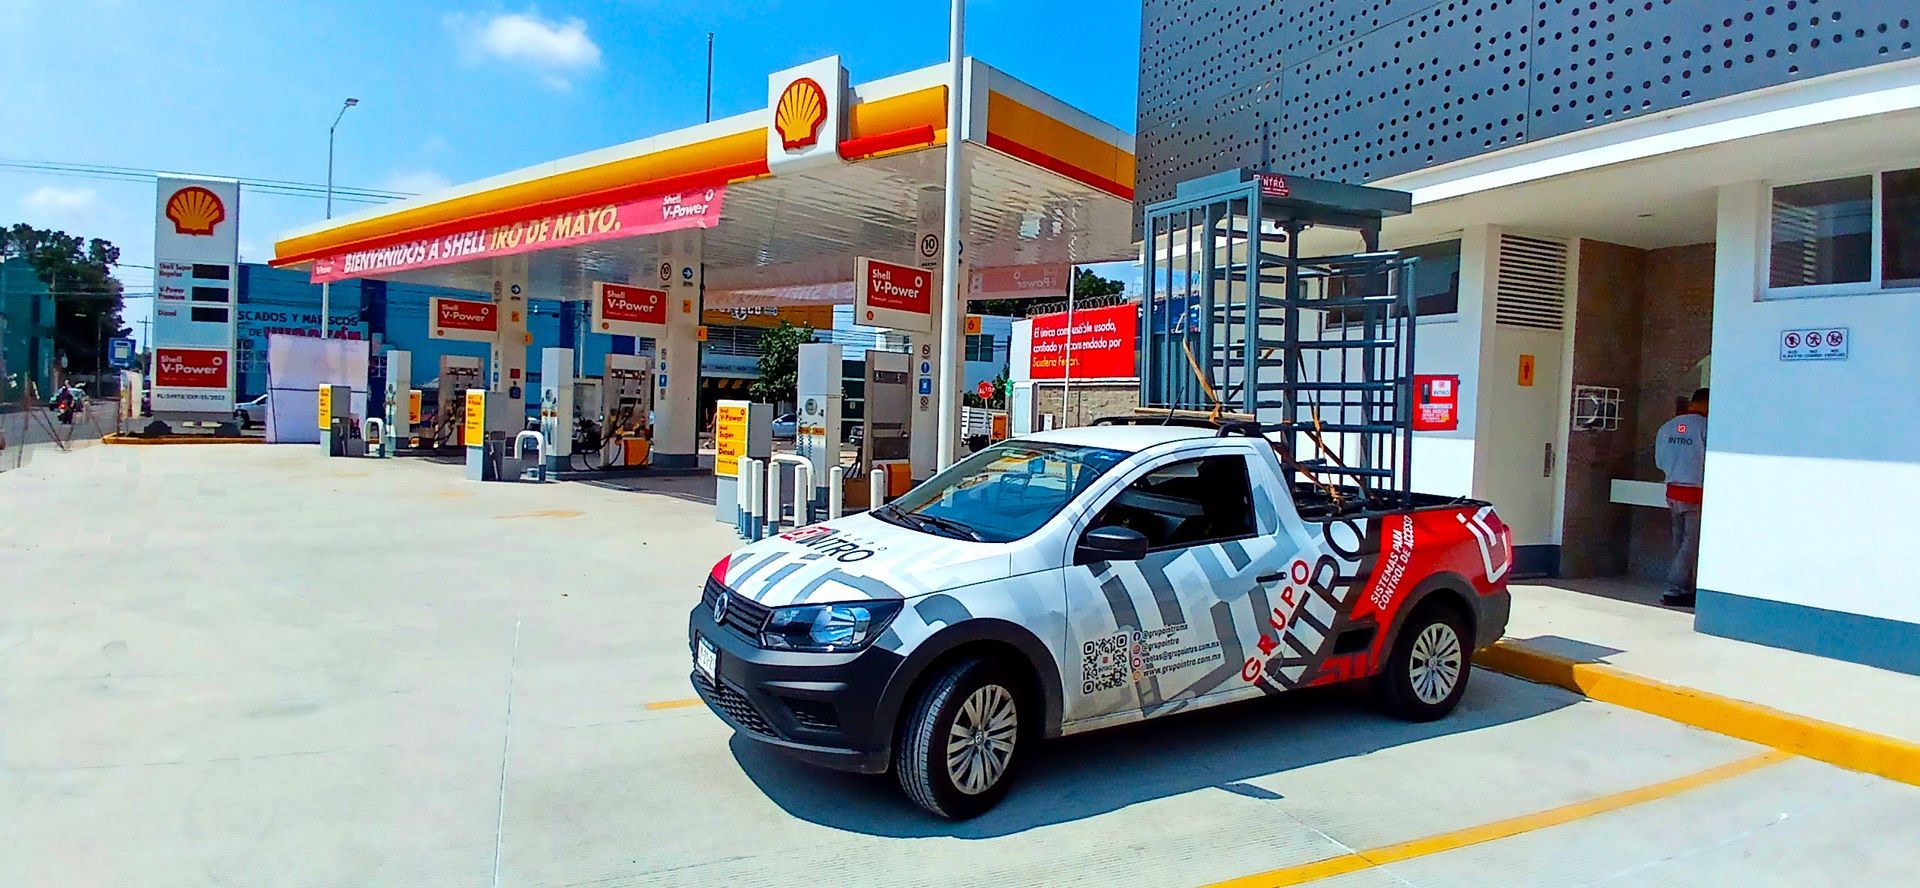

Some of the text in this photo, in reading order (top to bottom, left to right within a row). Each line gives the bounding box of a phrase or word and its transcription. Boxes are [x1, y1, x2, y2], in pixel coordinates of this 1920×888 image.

[662, 203, 709, 220] V-Power
[344, 240, 428, 273] BIENVENIDOS
[427, 238, 440, 261] A
[442, 229, 486, 259] SHELL
[525, 216, 550, 245] DE
[551, 204, 622, 241] MAYO.
[925, 238, 935, 250] 10
[872, 268, 891, 281] Shell
[607, 290, 626, 299] Shell
[872, 279, 920, 299] V-Power
[441, 303, 459, 311] Shell
[607, 298, 655, 313] V-Power
[237, 310, 288, 323] SCADOS
[292, 312, 299, 322] Y
[442, 311, 486, 322] V-Power
[968, 319, 975, 331] 6
[248, 327, 263, 337] DE
[1034, 326, 1040, 339] El
[1033, 340, 1058, 353] confiado
[1058, 344, 1063, 354] y
[1108, 339, 1122, 351] por
[160, 355, 182, 363] Shell
[161, 363, 219, 374] V-Power
[1668, 436, 1693, 446] INTRO
[1370, 529, 1403, 604] SISTEMAS PARA
[1377, 515, 1415, 611] CONTROL DE ACCESO
[1254, 520, 1363, 697] INTRO
[1242, 560, 1310, 682] GRUPO
